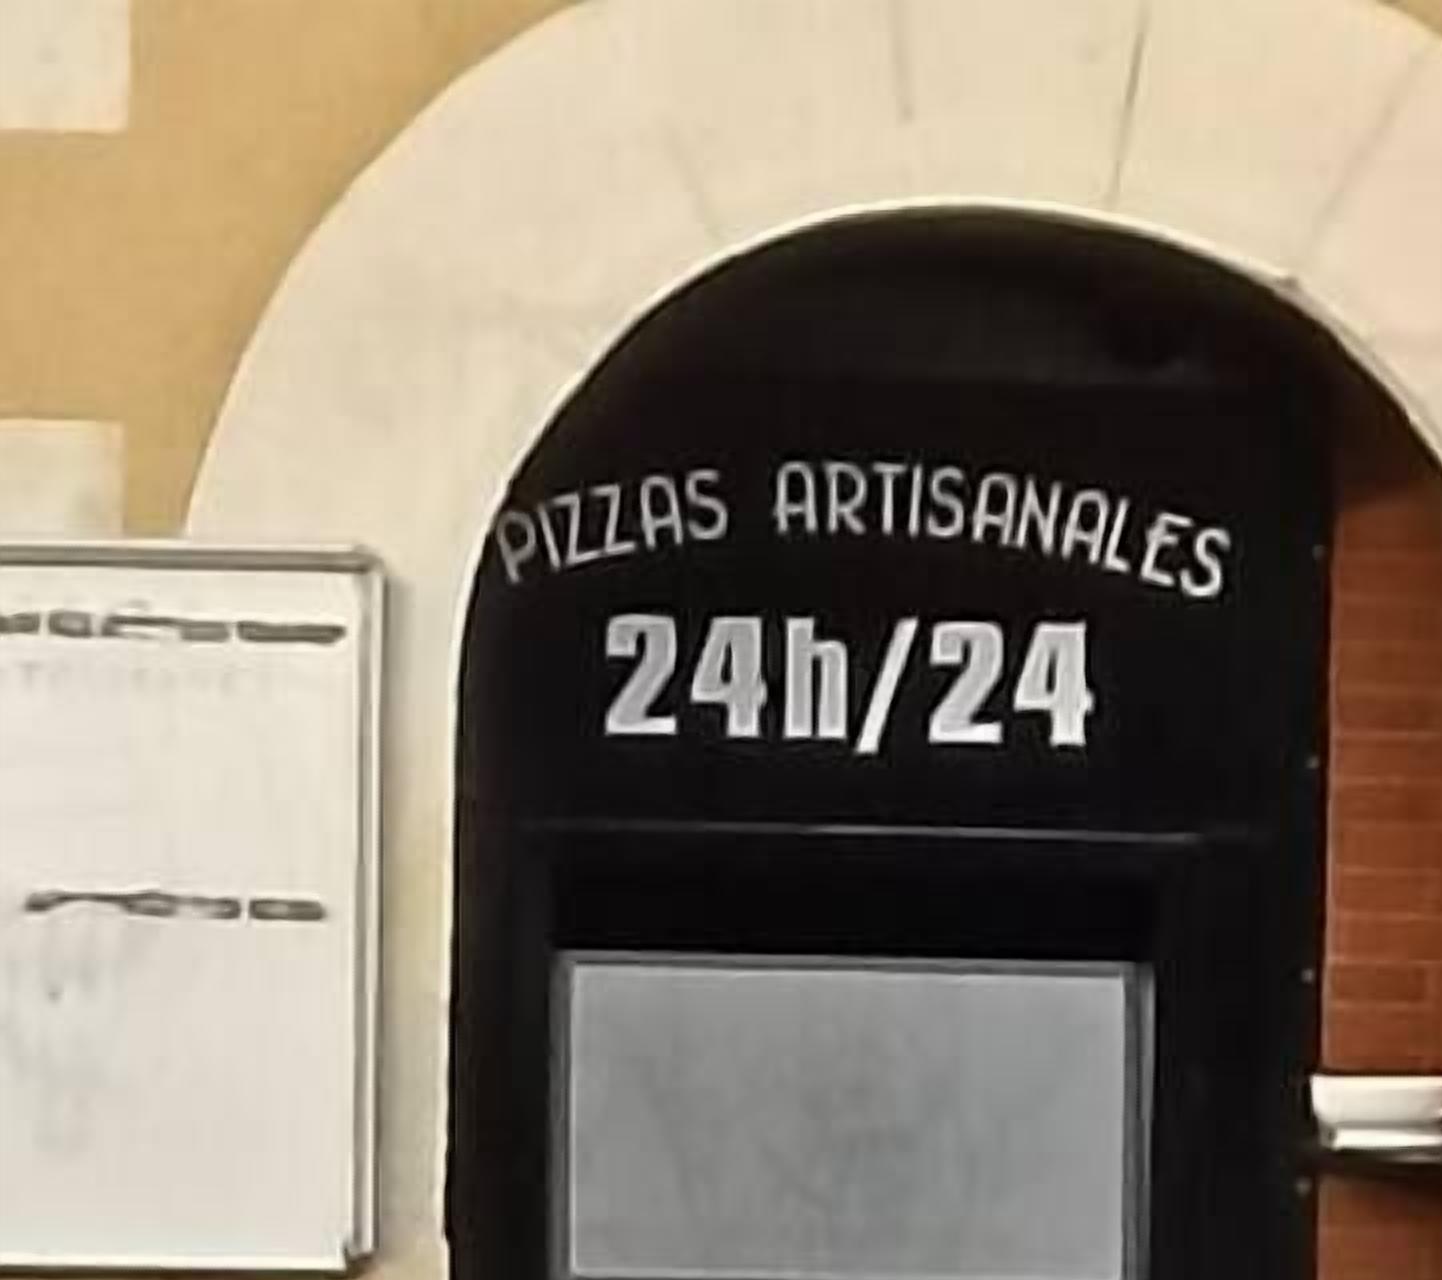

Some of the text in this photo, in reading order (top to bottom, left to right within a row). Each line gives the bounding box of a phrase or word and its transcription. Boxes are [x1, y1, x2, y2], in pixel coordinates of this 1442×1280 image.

[496, 461, 1231, 598] PIZZAS ARTISANALES
[604, 613, 1094, 754] 24h/24
